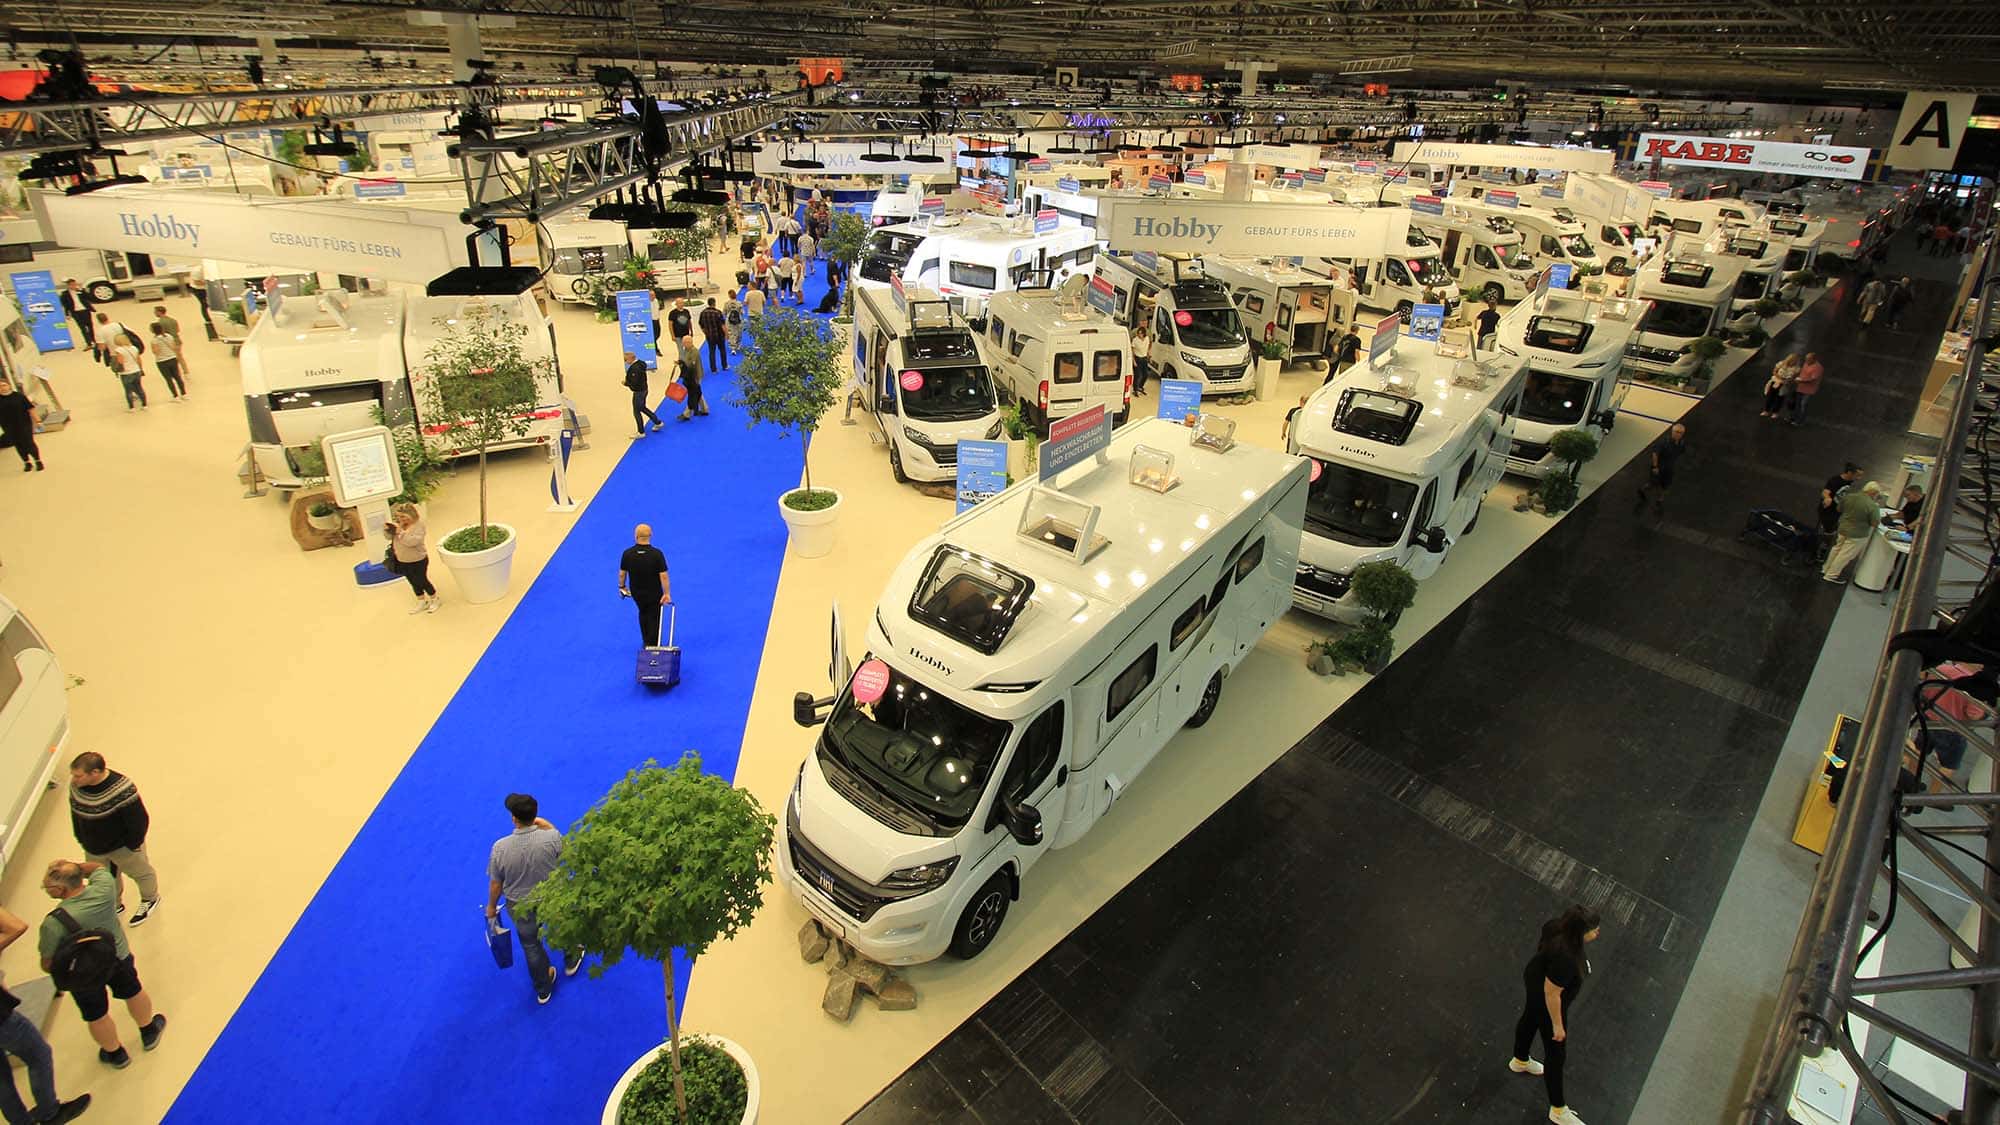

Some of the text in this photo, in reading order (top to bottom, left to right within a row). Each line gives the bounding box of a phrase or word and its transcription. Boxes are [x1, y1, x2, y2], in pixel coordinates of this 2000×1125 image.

[1899, 100, 1951, 149] A
[1423, 149, 1462, 160] Hobby
[1644, 138, 1755, 165] KABE
[119, 213, 201, 248] Hobby
[1133, 216, 1223, 244] Hobby
[1244, 226, 1288, 236] GEBAUT
[1321, 228, 1356, 238] LEBEN
[270, 232, 401, 258] GEBAUT FÜRS LEBEN
[305, 368, 344, 377] Hobby
[1051, 424, 1104, 457] HECKWASCHRAUM
[1050, 455, 1064, 468] UND
[910, 647, 955, 677] Hobby
